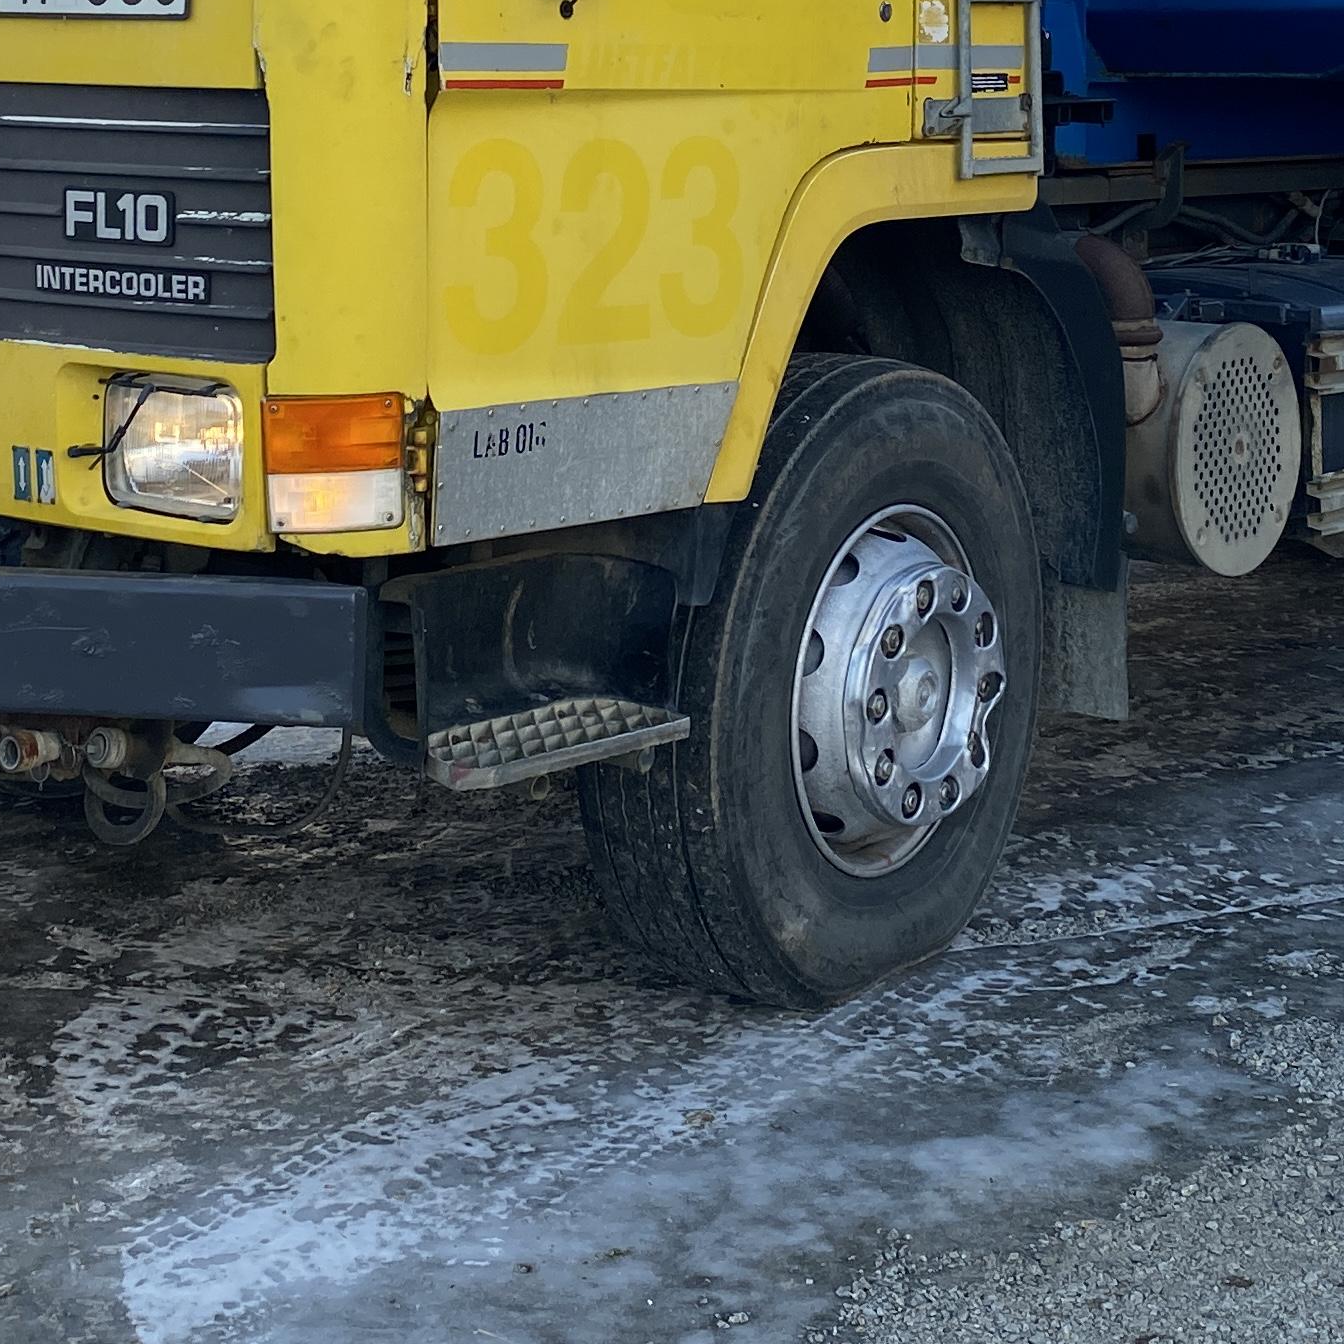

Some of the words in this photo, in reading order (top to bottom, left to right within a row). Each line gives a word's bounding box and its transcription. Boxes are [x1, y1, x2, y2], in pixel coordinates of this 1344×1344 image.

[65, 189, 168, 242] FL10
[442, 136, 744, 356] 323
[36, 264, 206, 300] INTERCOOLER
